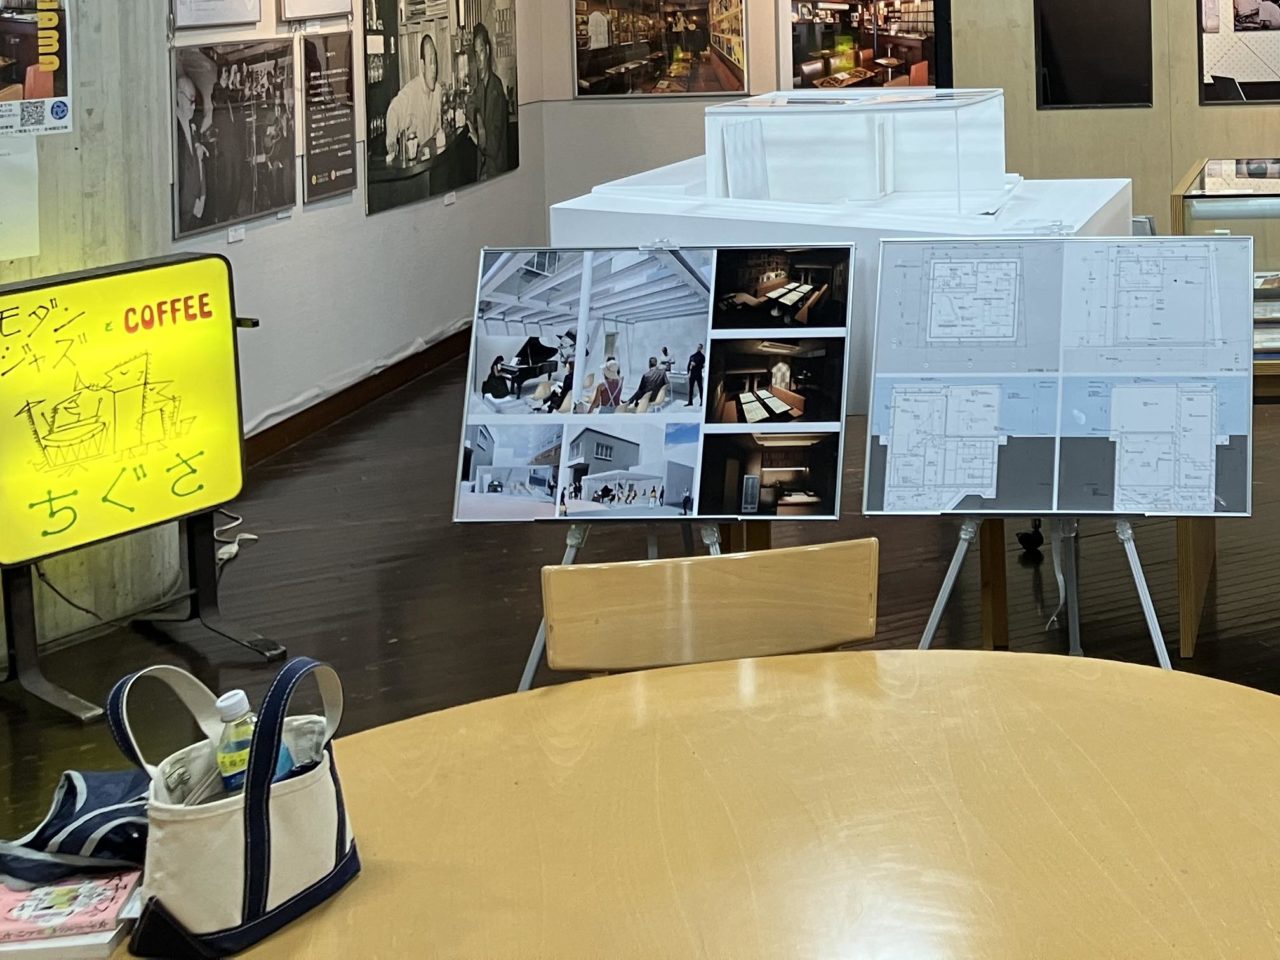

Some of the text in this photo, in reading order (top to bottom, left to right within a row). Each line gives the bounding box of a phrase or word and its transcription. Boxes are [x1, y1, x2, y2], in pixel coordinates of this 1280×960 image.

[124, 292, 213, 334] COFFEE
[28, 450, 205, 537] ちぐさ
